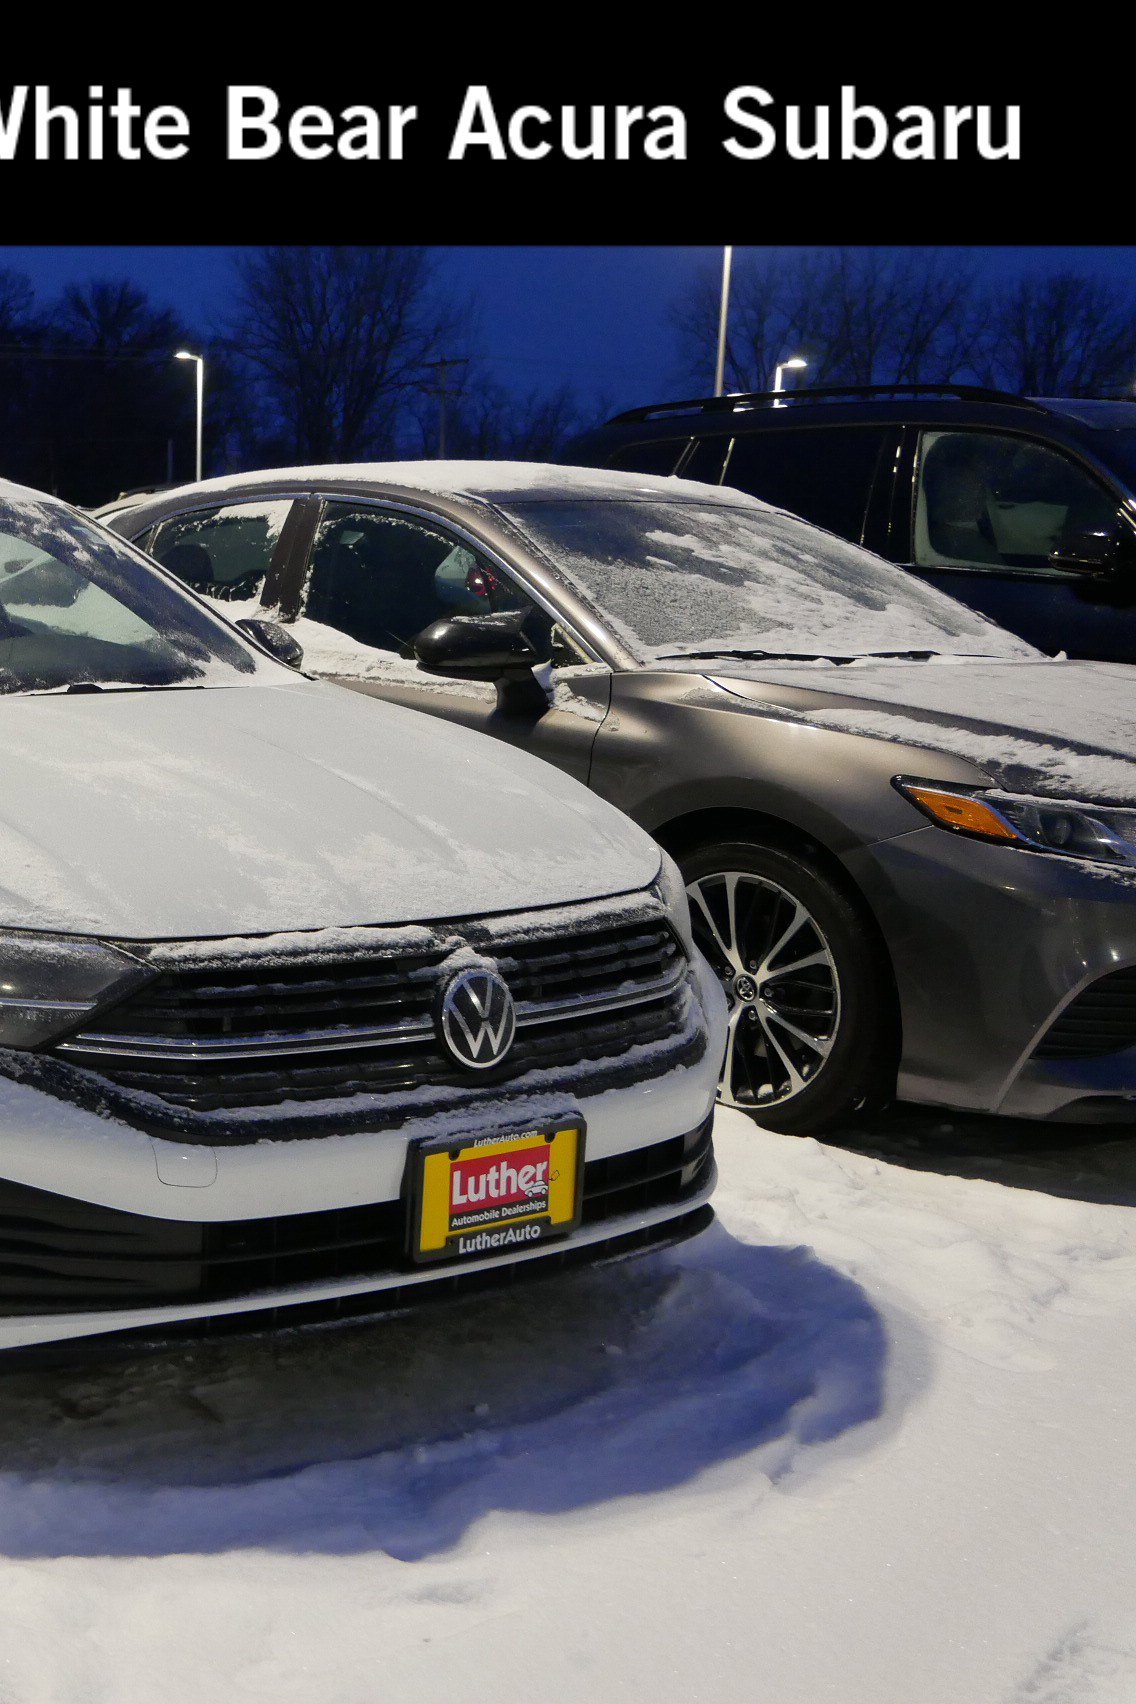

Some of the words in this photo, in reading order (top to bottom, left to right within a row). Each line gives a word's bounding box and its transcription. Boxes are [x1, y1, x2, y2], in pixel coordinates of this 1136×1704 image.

[473, 1130, 538, 1148] LutherAuto.com
[452, 1161, 548, 1206] Luther
[451, 1209, 500, 1227] Automobile
[501, 1200, 547, 1217] Dealerships
[458, 1224, 541, 1254] LutherAuto
